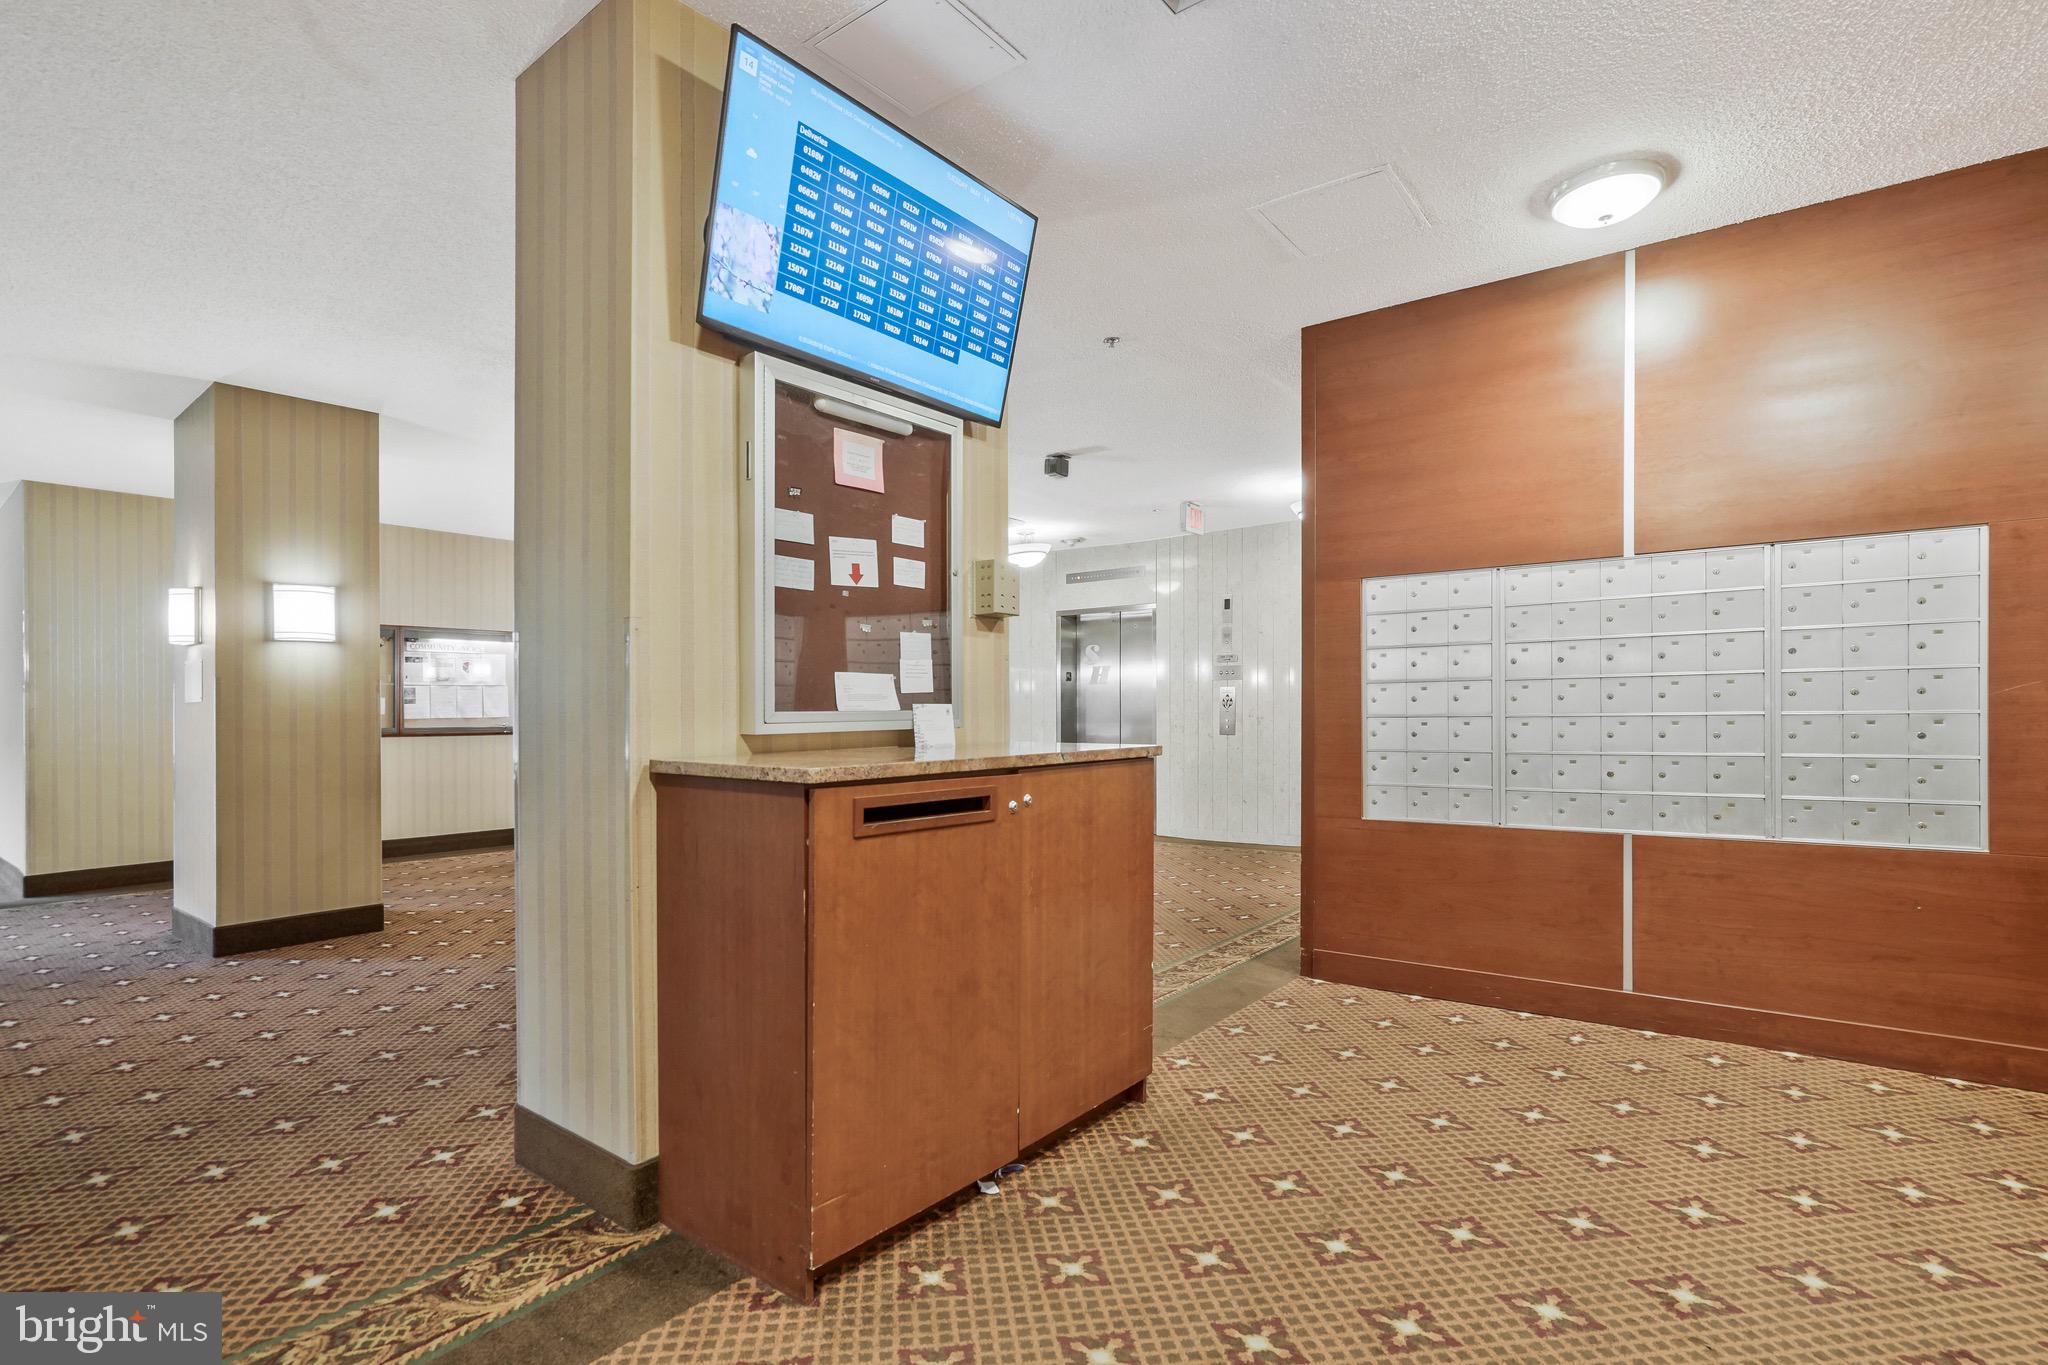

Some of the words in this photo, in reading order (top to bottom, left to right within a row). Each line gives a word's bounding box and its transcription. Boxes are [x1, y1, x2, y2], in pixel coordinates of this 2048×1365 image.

[744, 56, 753, 70] 14
[799, 124, 828, 148] Deliveries
[1089, 666, 1111, 684] H
